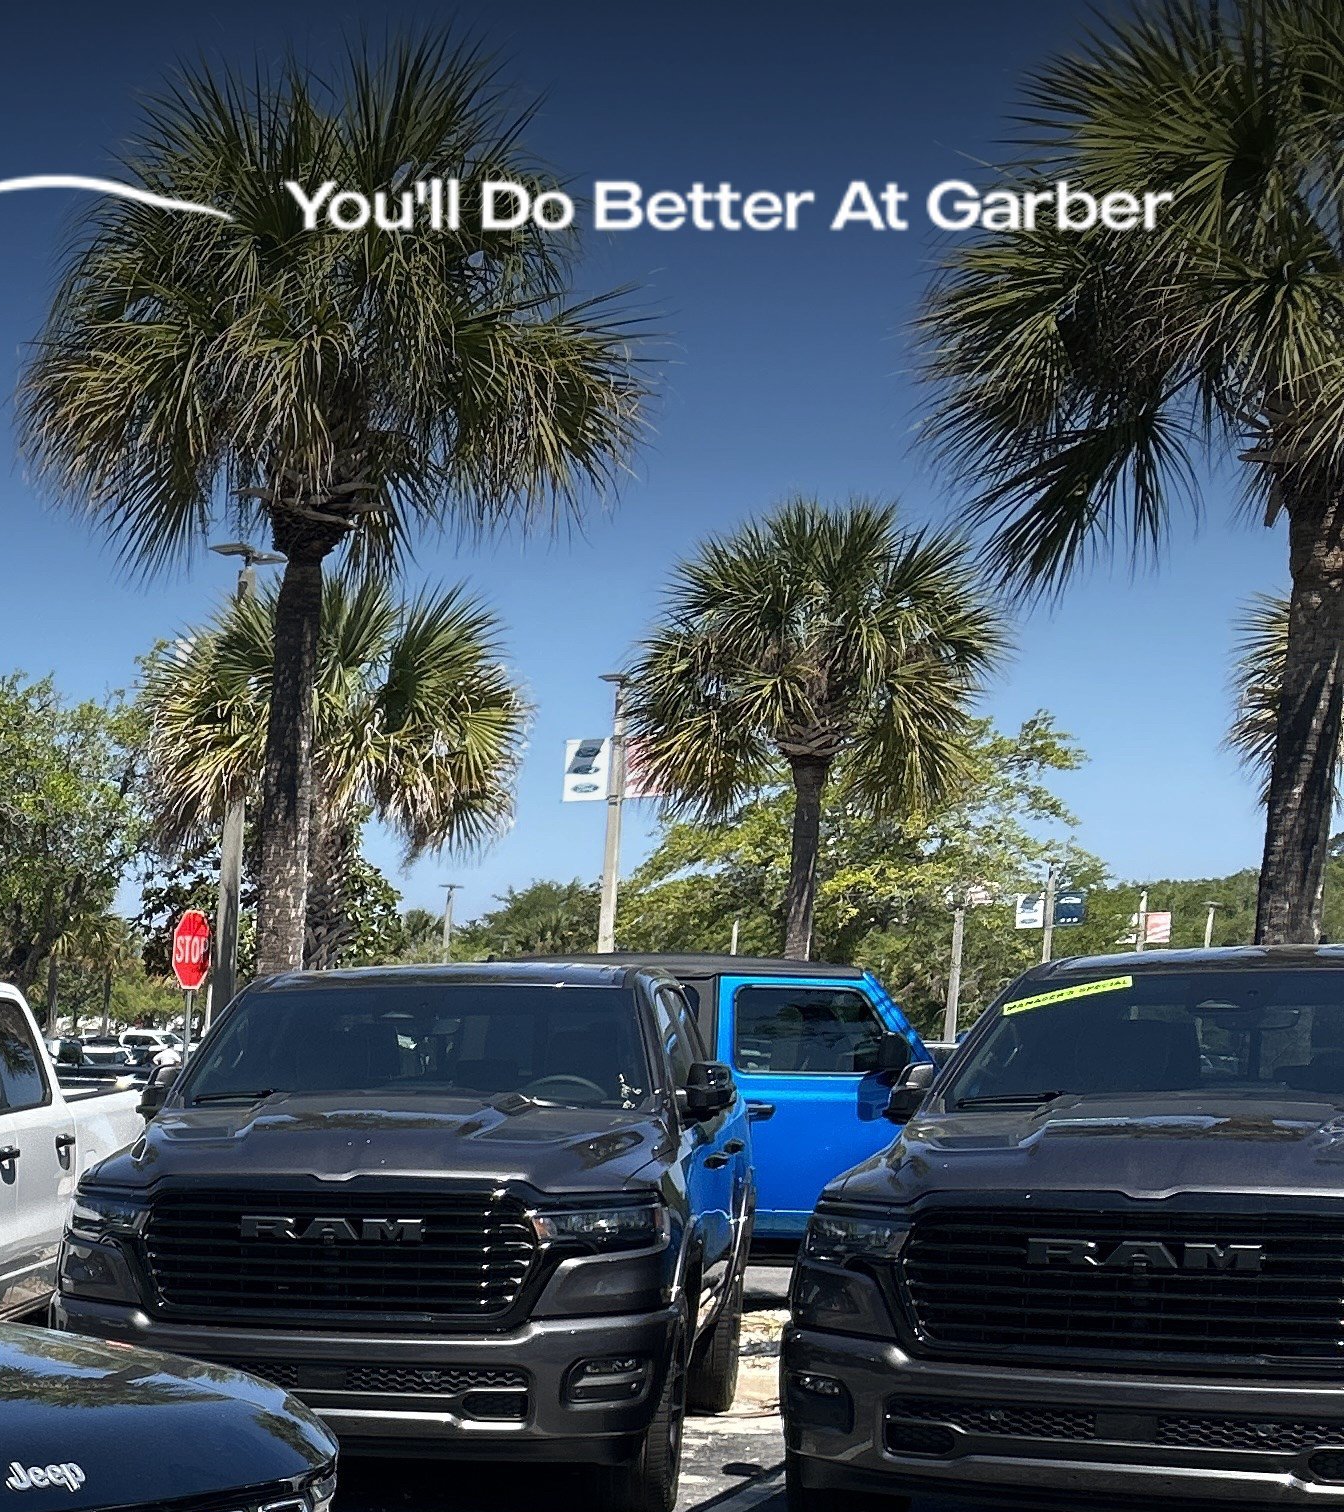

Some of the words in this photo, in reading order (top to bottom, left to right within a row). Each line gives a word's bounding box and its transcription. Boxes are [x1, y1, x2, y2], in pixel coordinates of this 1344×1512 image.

[175, 935, 209, 964] STOP
[240, 1215, 423, 1242] RAM
[1027, 1237, 1262, 1270] RAM
[5, 1461, 86, 1493] Jeep
